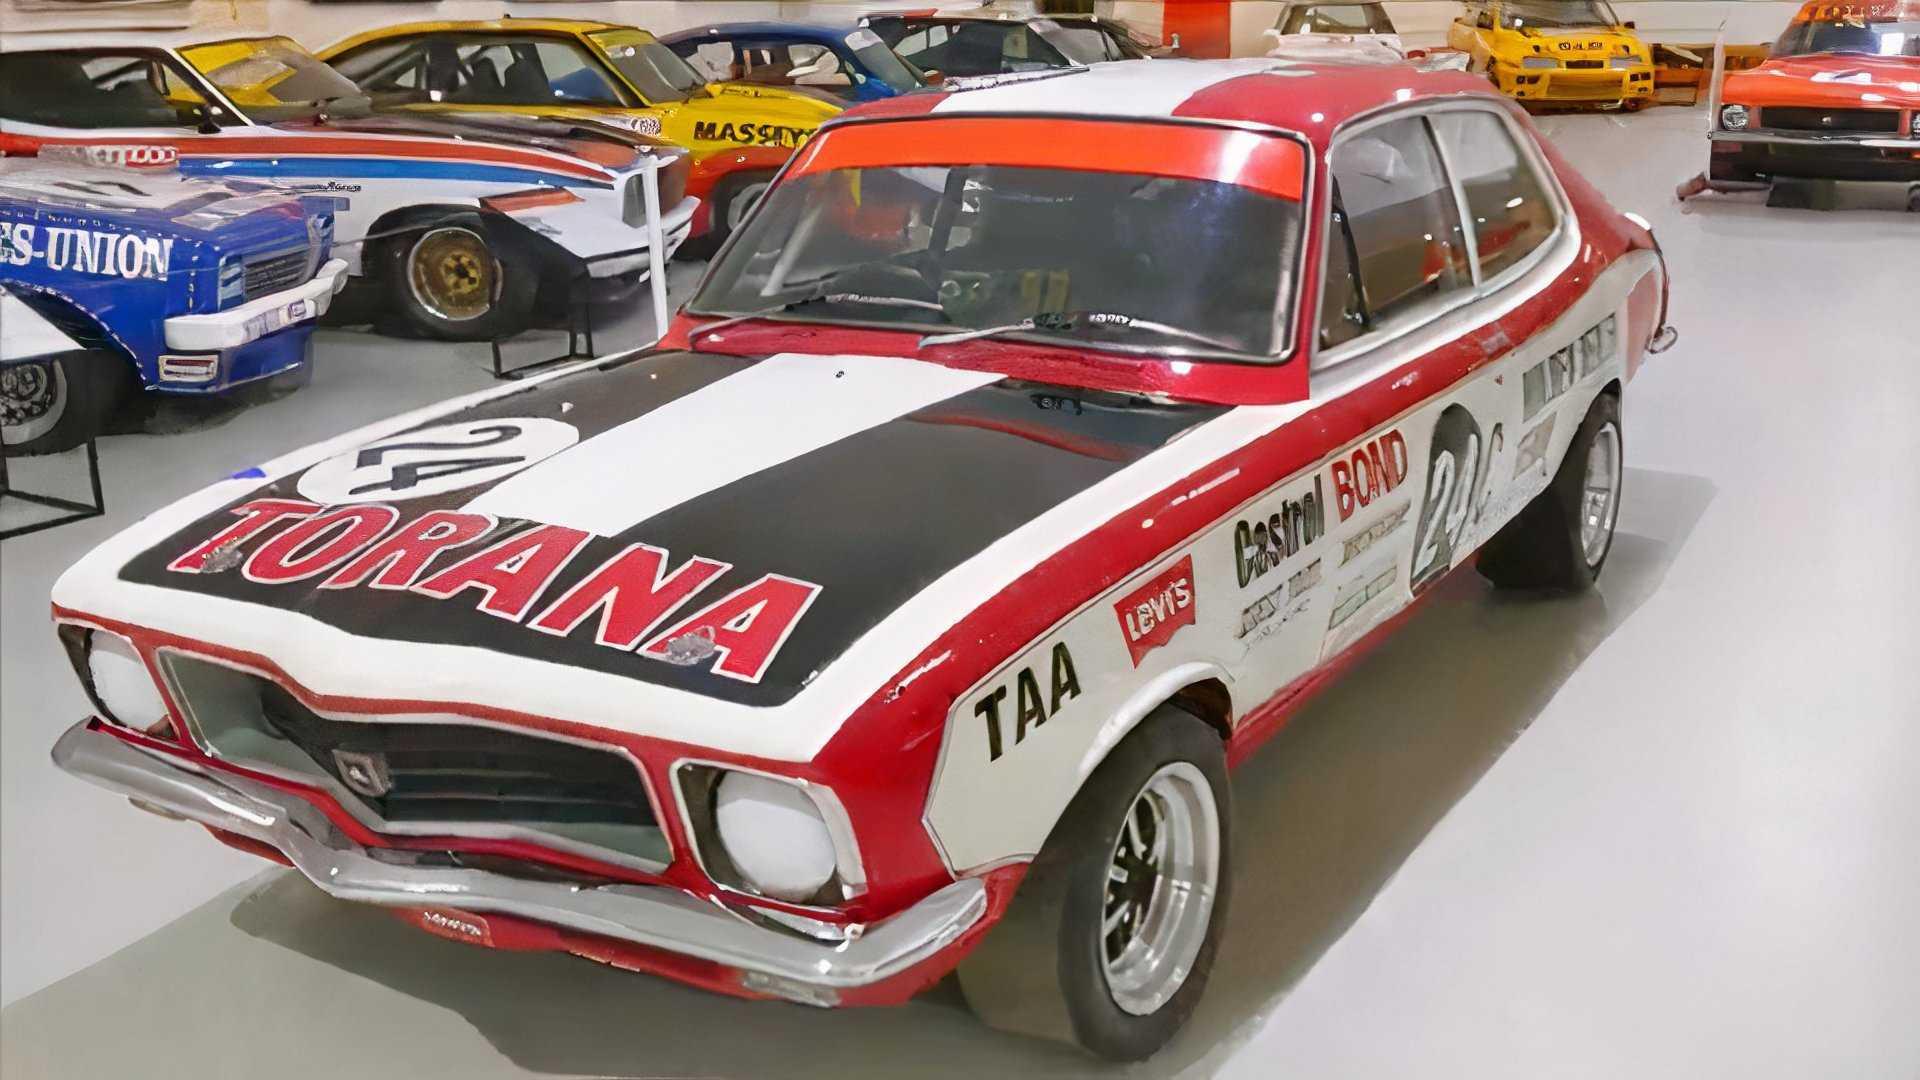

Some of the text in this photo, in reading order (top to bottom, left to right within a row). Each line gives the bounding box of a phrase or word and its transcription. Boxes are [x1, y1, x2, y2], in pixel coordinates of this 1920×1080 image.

[348, 425, 526, 496] 24
[1331, 429, 1408, 524] BOND
[166, 498, 823, 684] TORANA
[974, 641, 1082, 763] TAA
